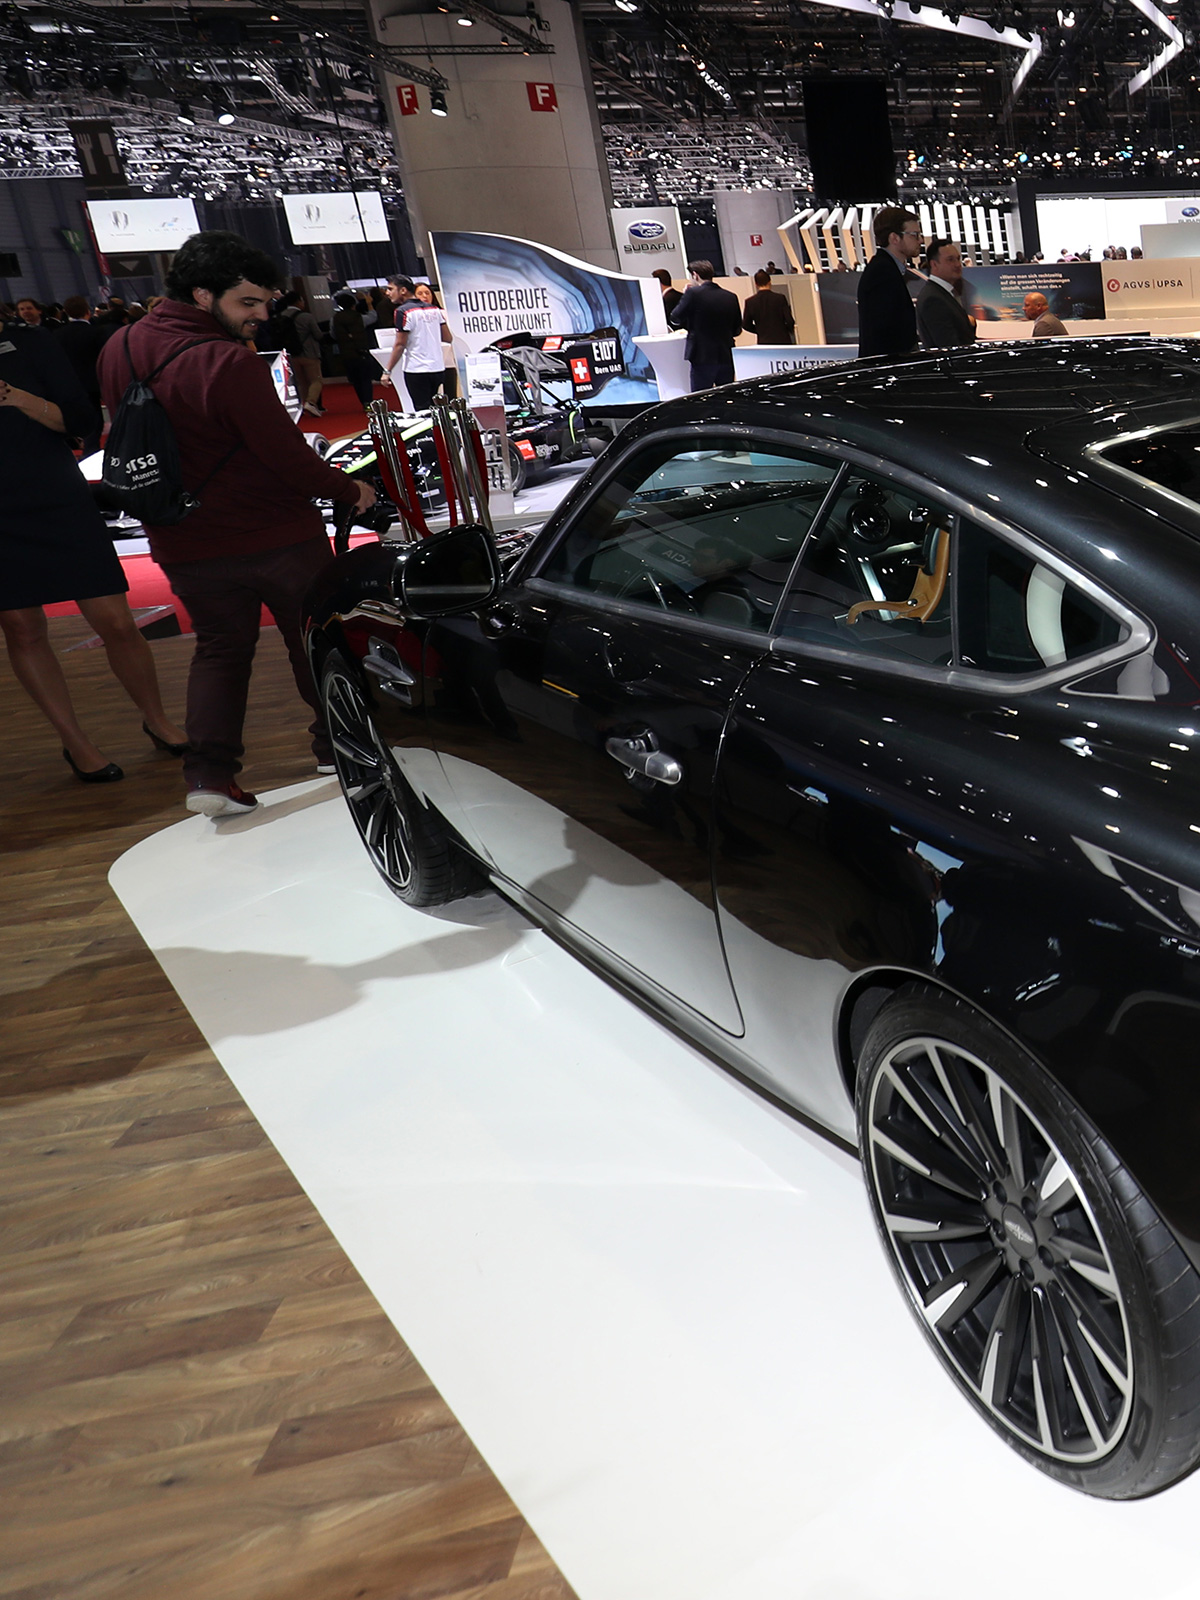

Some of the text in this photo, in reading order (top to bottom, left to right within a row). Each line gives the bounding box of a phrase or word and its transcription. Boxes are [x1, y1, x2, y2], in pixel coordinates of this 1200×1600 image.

[401, 86, 412, 108] F
[535, 85, 550, 105] F
[623, 241, 676, 253] SUBARU
[1123, 279, 1184, 289] AGVS UPSA
[458, 288, 549, 313] AUTOBERUFE
[462, 316, 502, 334] HABEN
[506, 312, 552, 331] ZUKUNFT
[591, 341, 617, 362] E107
[594, 363, 622, 375] Bern UAS
[770, 360, 789, 374] LES
